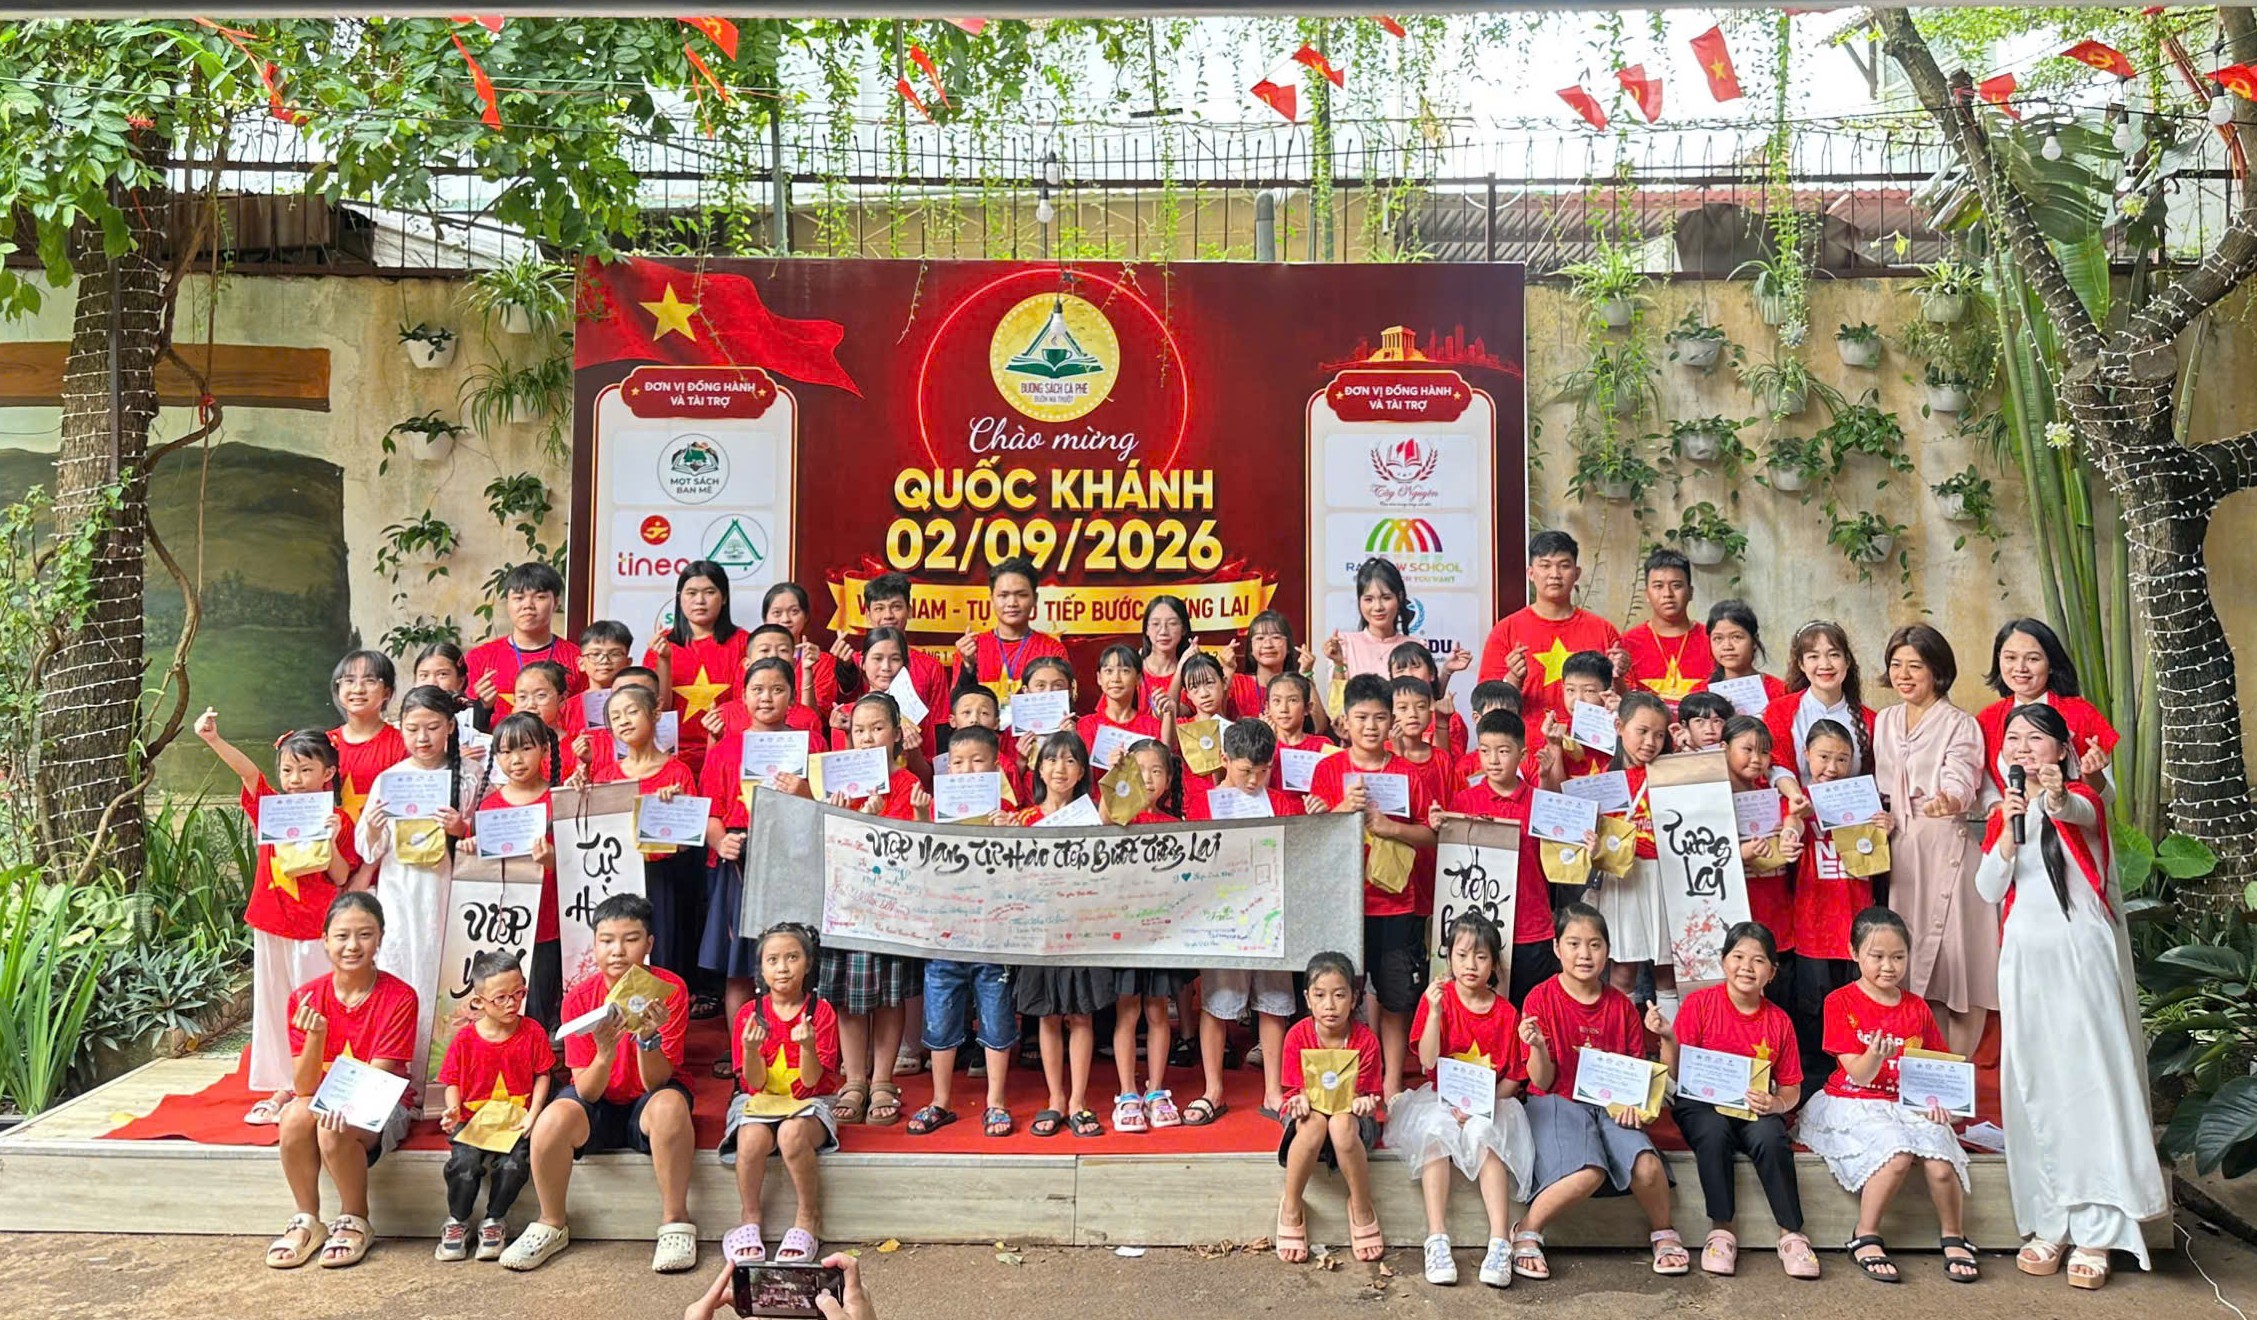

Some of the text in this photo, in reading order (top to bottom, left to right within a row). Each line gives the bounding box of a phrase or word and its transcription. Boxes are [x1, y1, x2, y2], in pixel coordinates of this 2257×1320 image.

[644, 381, 671, 392] ĐƠN
[673, 382, 685, 394] VỊ
[724, 380, 756, 392] HÀNH
[1344, 386, 1370, 396] ĐƠN
[1372, 386, 1383, 398] VỊ
[1421, 384, 1452, 396] HÀNH
[670, 395, 731, 408] VÀ TÀI TRỢ
[1369, 399, 1428, 412] VÀ TÀI TRỢ
[969, 416, 1140, 463] Chào mừng
[693, 475, 720, 485] SÁCH
[893, 455, 1215, 513] QUỐC KHÁNH
[676, 486, 697, 494] BAN
[885, 517, 1224, 574] 02/09/2026
[1409, 562, 1463, 573] SCHOOL
[1044, 593, 1086, 622] TIẾP
[1091, 595, 1144, 622] BƯỚC
[1220, 595, 1249, 618] LAI
